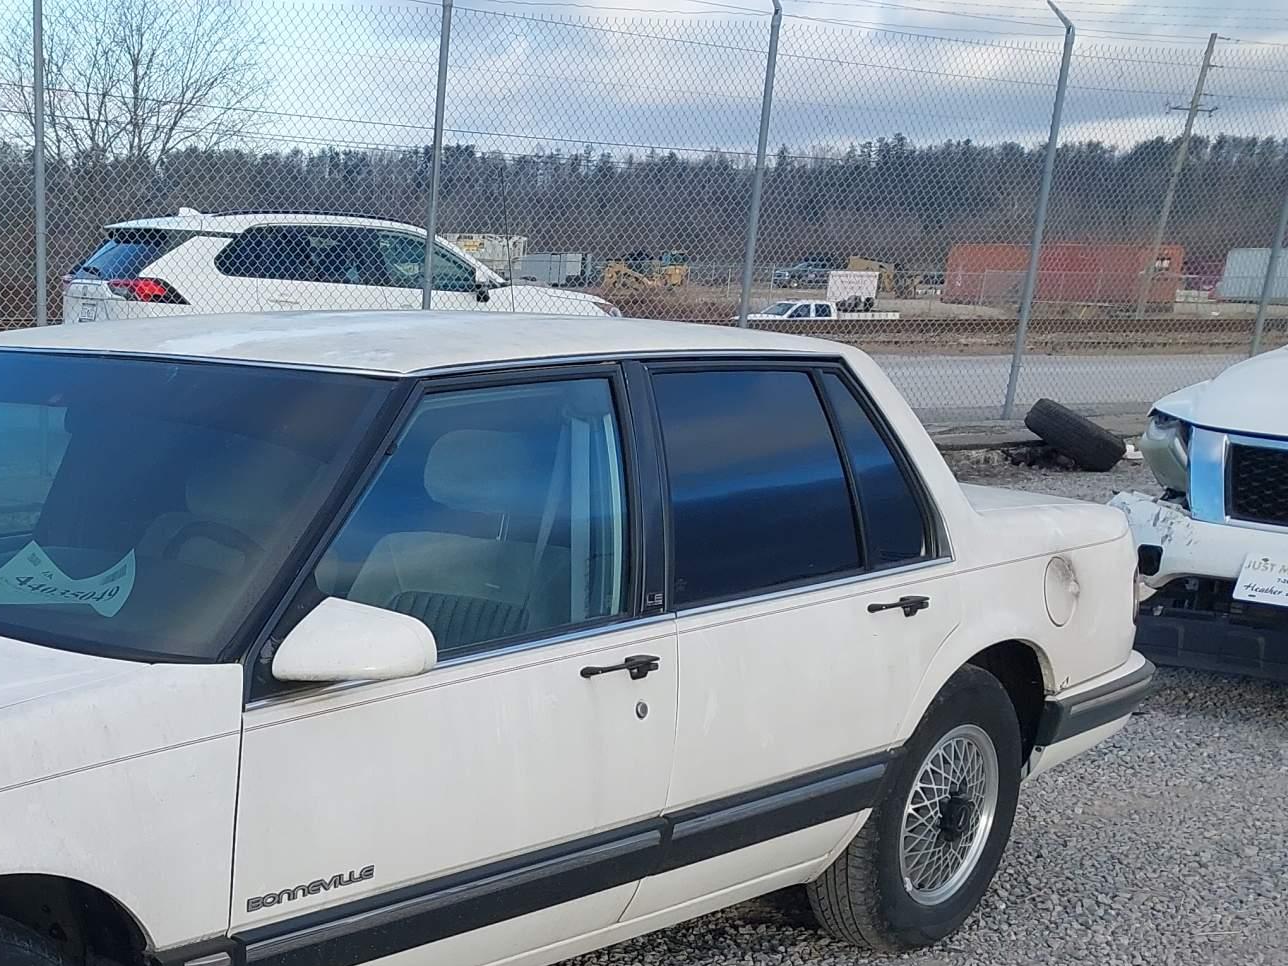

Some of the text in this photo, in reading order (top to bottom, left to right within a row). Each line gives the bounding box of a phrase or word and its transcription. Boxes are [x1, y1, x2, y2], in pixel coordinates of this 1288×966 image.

[1245, 560, 1277, 572] JUST
[16, 576, 120, 601] 44035049
[247, 864, 375, 912] BONNEVILLE
